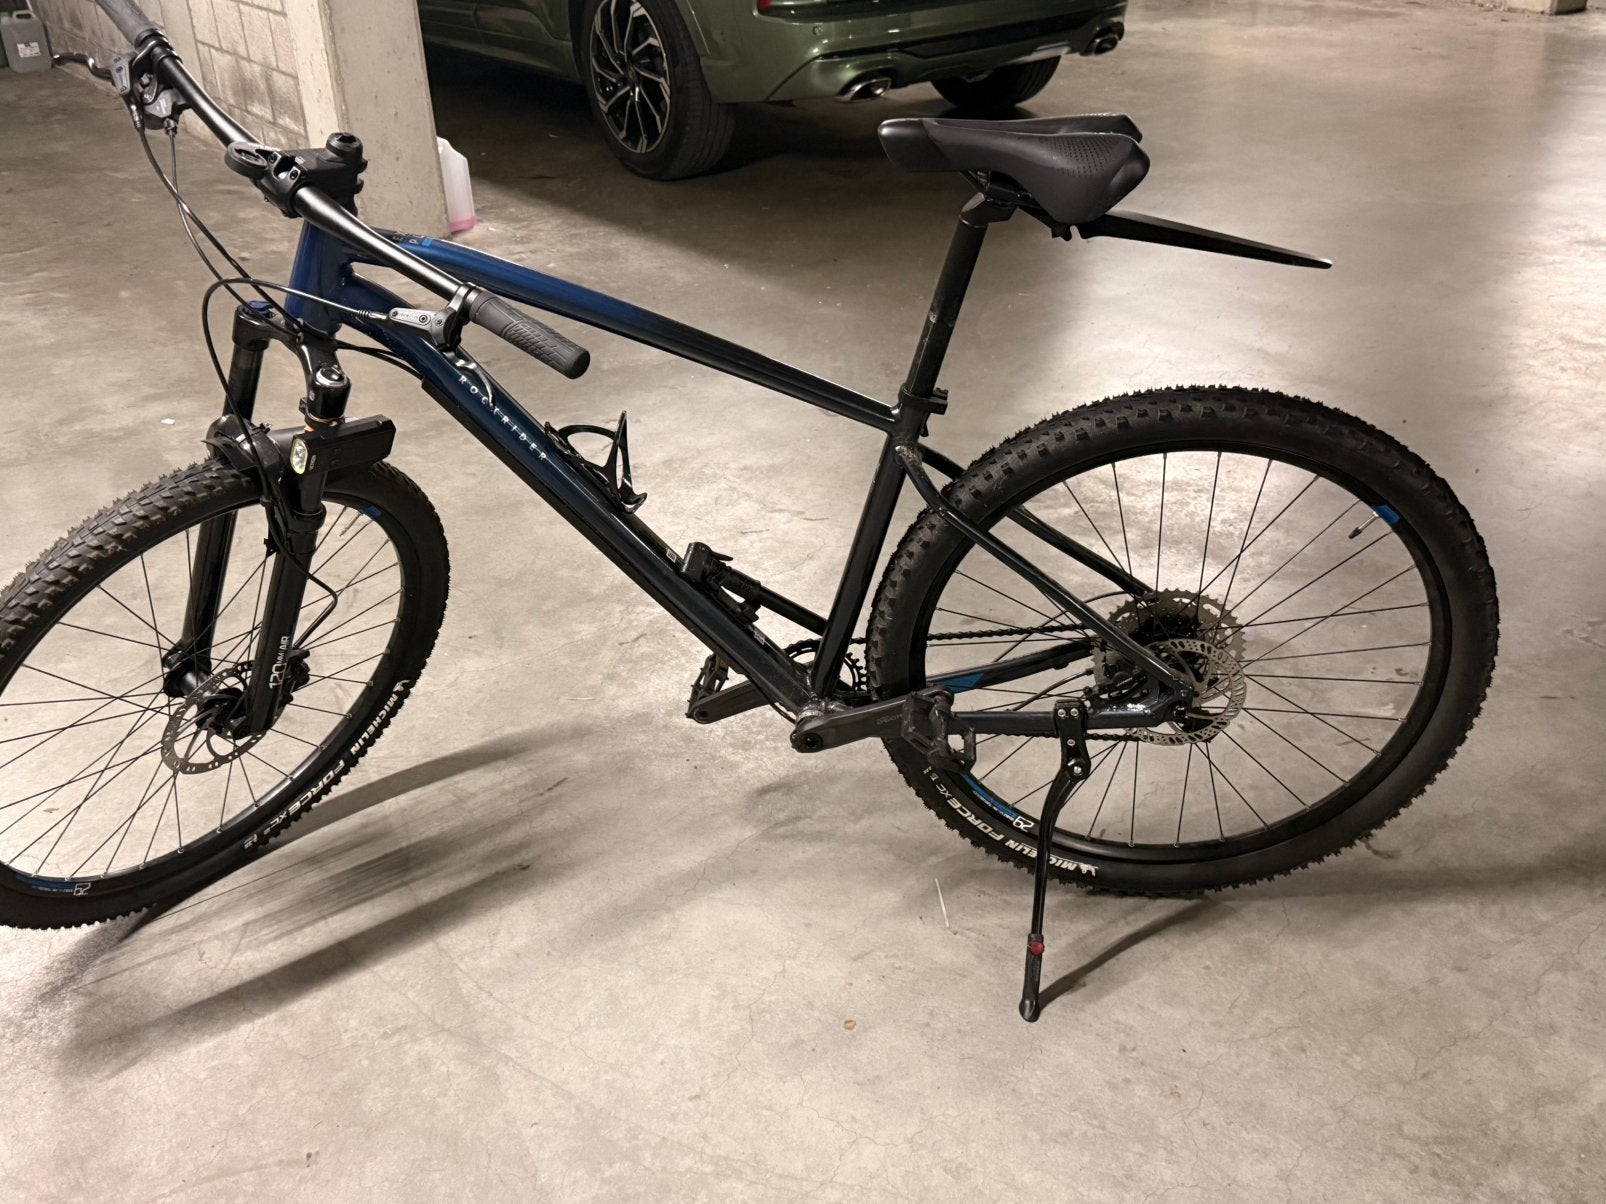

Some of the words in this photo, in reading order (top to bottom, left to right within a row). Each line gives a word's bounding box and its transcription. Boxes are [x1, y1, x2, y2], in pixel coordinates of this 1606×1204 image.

[350, 693, 399, 756] MICHELIN
[288, 760, 346, 816] FORCE
[947, 797, 1005, 842] FORCE
[1012, 815, 1035, 833] 29
[1005, 839, 1078, 872] MICELIN
